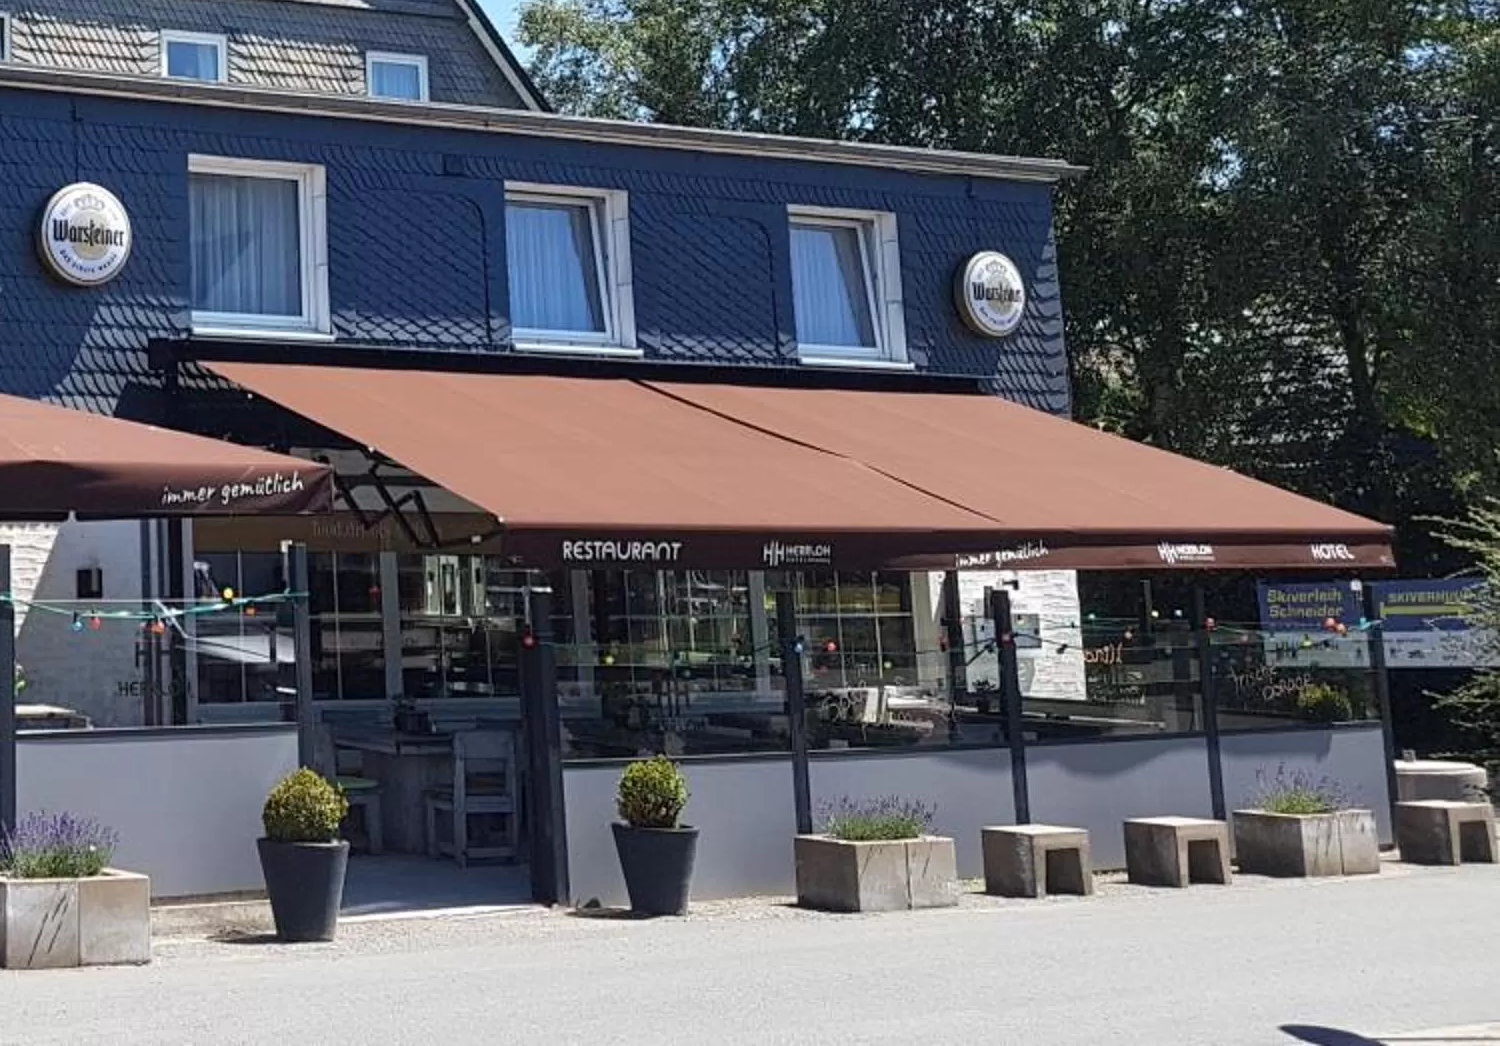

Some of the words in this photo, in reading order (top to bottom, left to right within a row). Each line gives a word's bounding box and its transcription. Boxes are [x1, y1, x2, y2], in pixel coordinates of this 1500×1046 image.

[161, 486, 216, 504] immer
[221, 470, 304, 504] gemütlich
[562, 540, 682, 561] RESTAURANT
[1311, 543, 1355, 560] HOTEL
